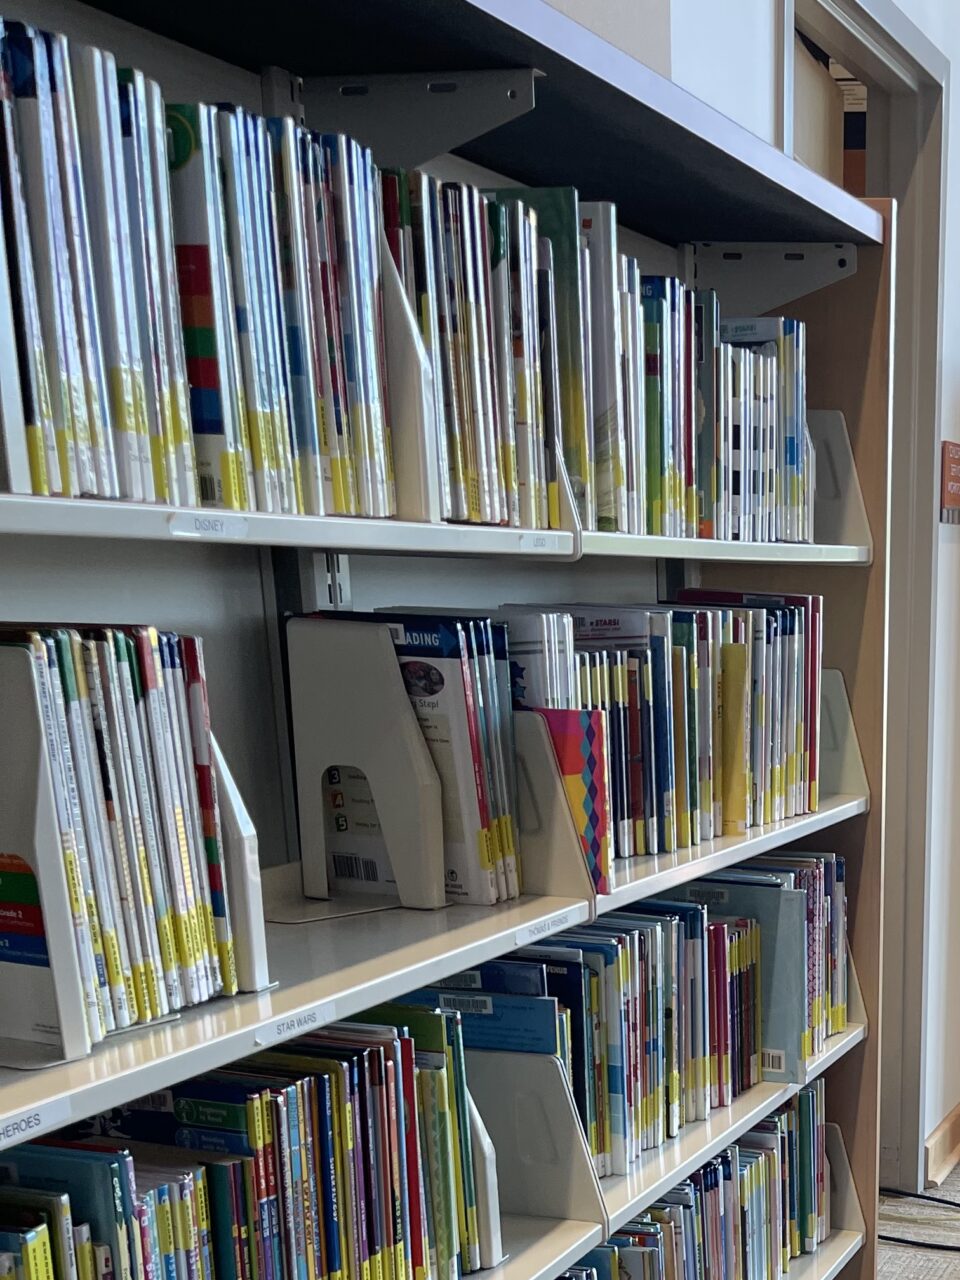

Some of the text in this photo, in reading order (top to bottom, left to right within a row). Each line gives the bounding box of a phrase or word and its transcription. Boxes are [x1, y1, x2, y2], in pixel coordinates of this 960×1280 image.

[194, 518, 224, 532] DISNEY
[276, 1012, 317, 1035] STAR WARS
[0, 1113, 41, 1139] HEROES
